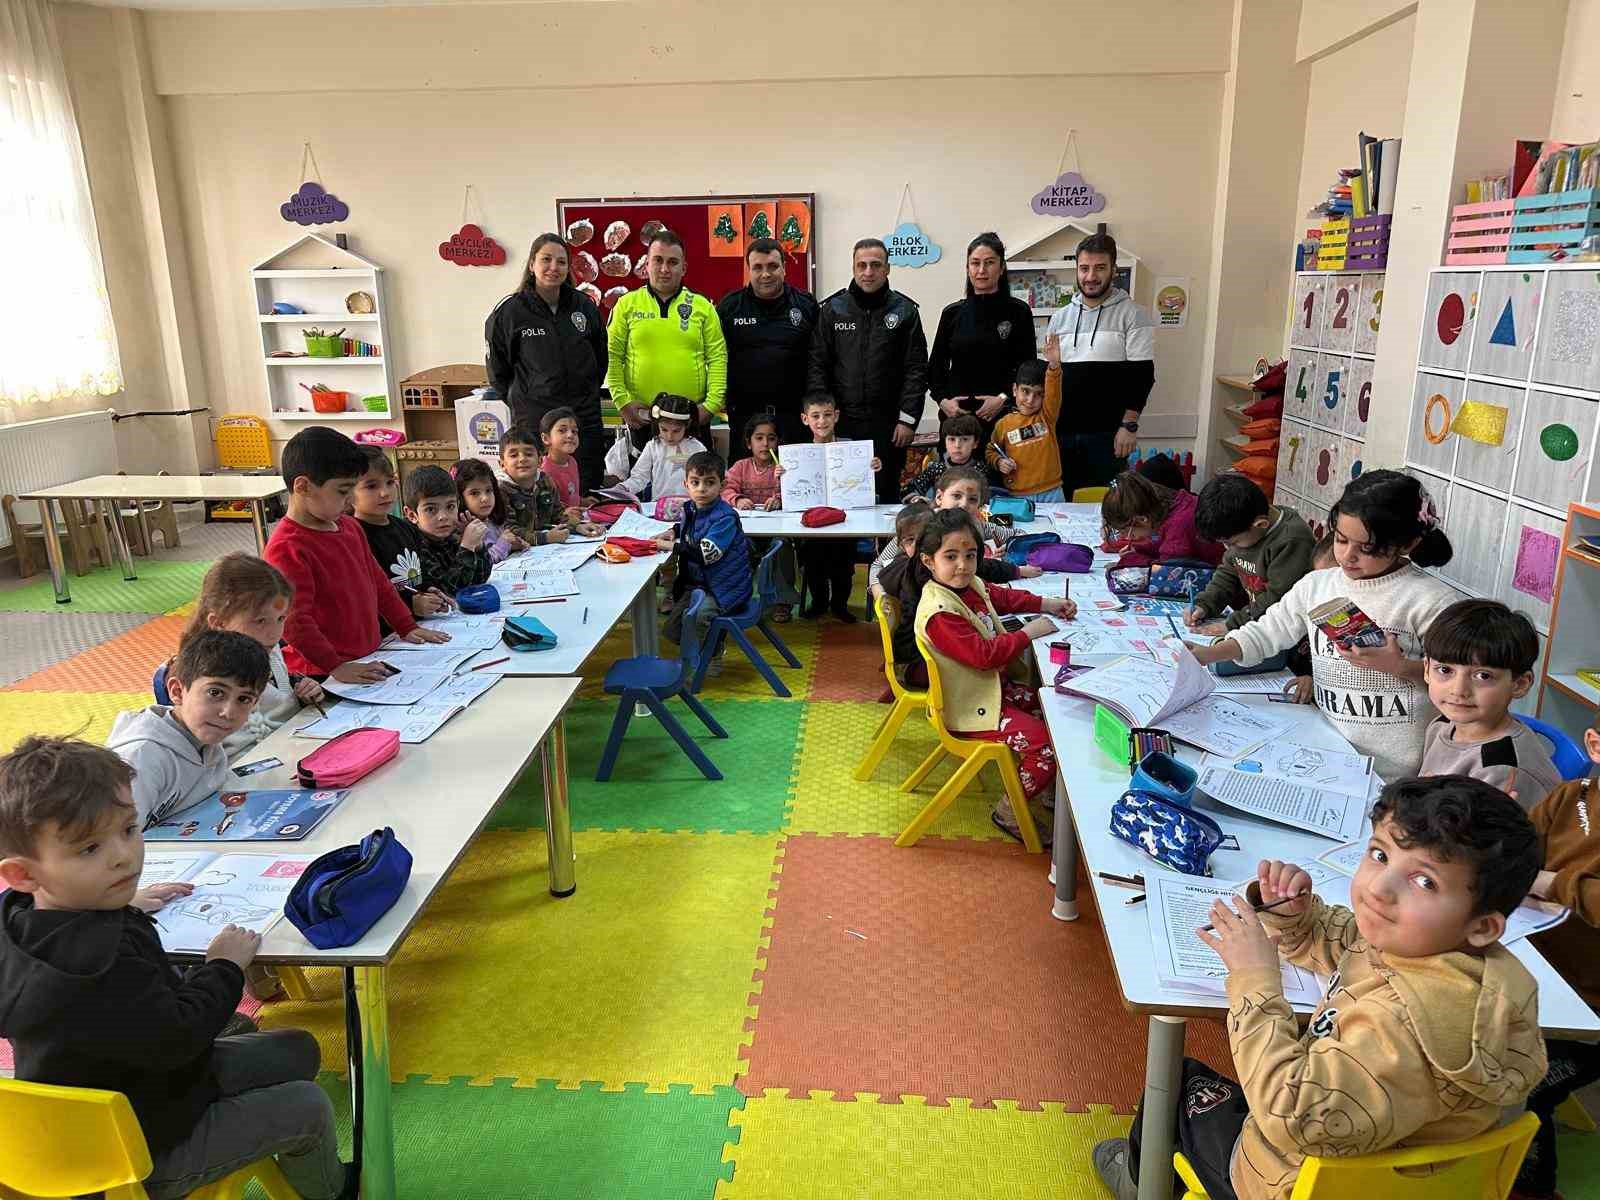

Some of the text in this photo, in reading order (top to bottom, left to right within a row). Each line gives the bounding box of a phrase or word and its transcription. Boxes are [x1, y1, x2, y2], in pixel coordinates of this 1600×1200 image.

[888, 245, 928, 256] ERKEZİ
[892, 236, 922, 246] BLOK
[1303, 291, 1315, 329] 1
[1332, 287, 1350, 329] 2
[1295, 366, 1308, 404] 4
[1323, 371, 1341, 410] 5
